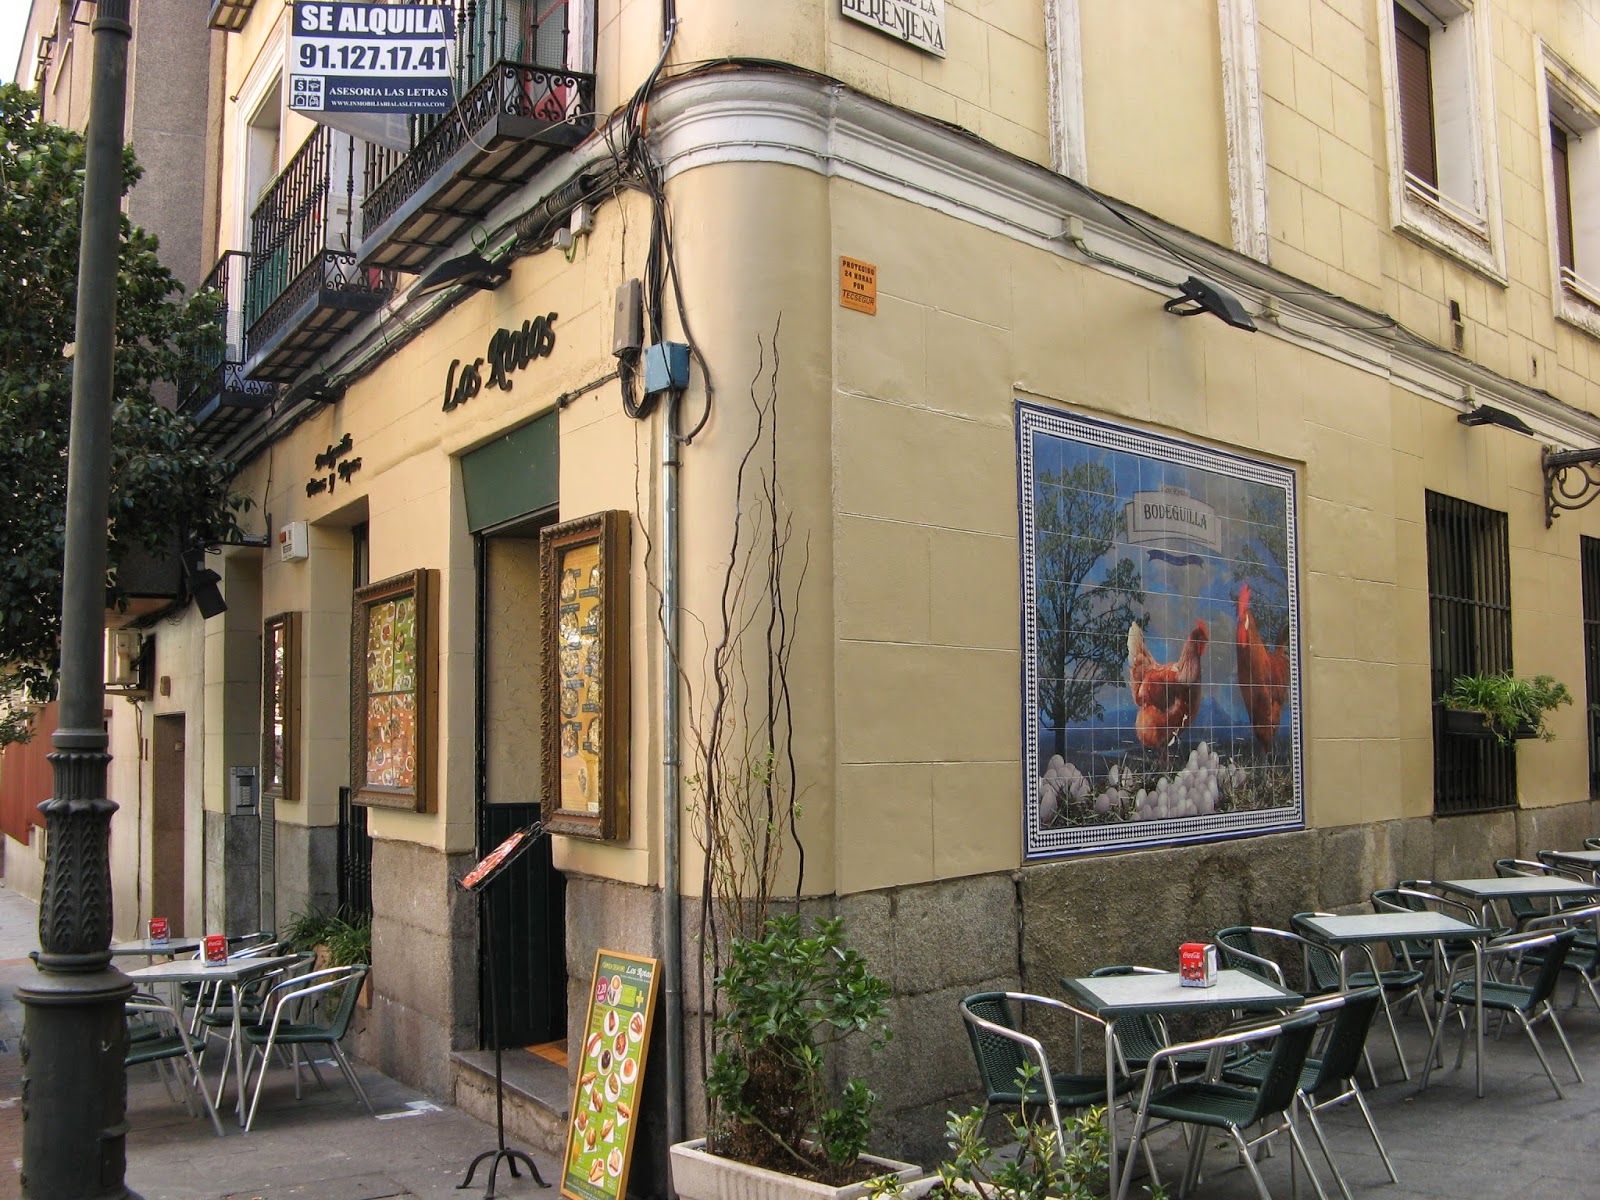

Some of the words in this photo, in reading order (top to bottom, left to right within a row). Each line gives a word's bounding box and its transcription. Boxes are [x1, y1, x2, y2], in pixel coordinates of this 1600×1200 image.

[301, 4, 334, 31] SE
[338, 7, 446, 35] ALQUILA
[299, 43, 447, 70] 91.127.17.41
[329, 87, 382, 96] ASESORIA
[384, 88, 405, 96] LAS
[407, 88, 449, 97] LETRAS
[842, 290, 875, 305] TECSEGUR
[853, 281, 865, 291] POR
[442, 358, 484, 412] Los
[1143, 503, 1208, 530] BODEGUILLA
